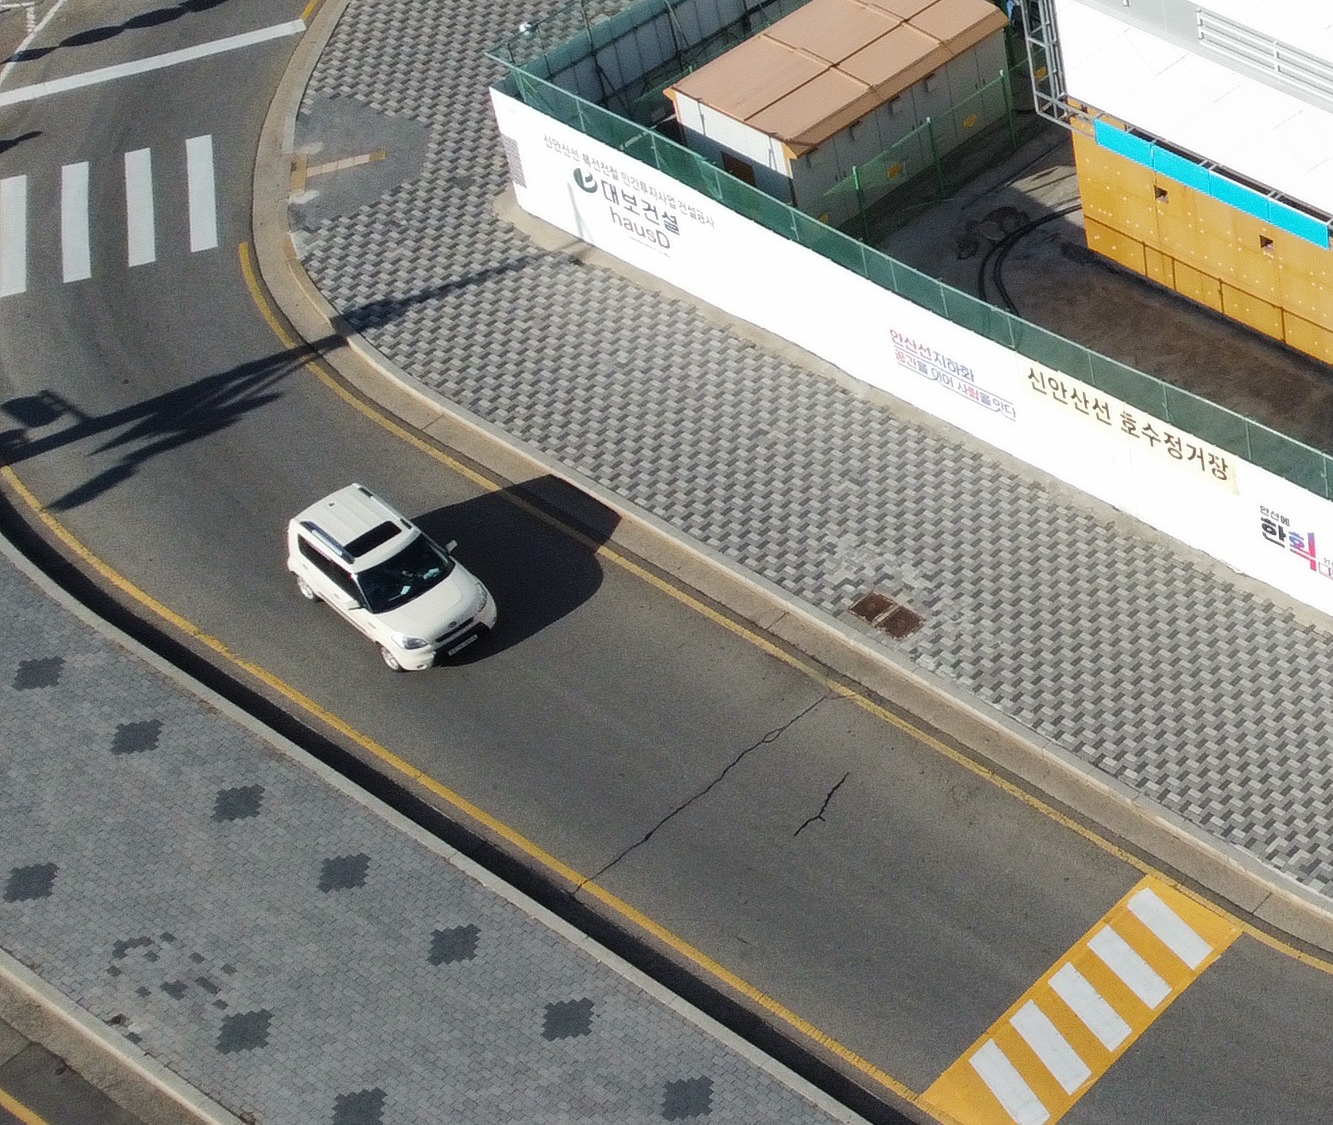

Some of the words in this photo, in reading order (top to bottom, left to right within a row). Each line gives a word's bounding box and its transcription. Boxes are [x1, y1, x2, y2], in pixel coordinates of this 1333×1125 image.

[601, 179, 681, 236] 대보건설
[609, 206, 671, 250] hausD
[678, 200, 715, 229] 건설공사
[890, 329, 975, 383] 안산선지하화
[895, 350, 929, 376] 공간을
[1028, 367, 1113, 427] 신안산선
[1120, 410, 1229, 481] 호수정거장
